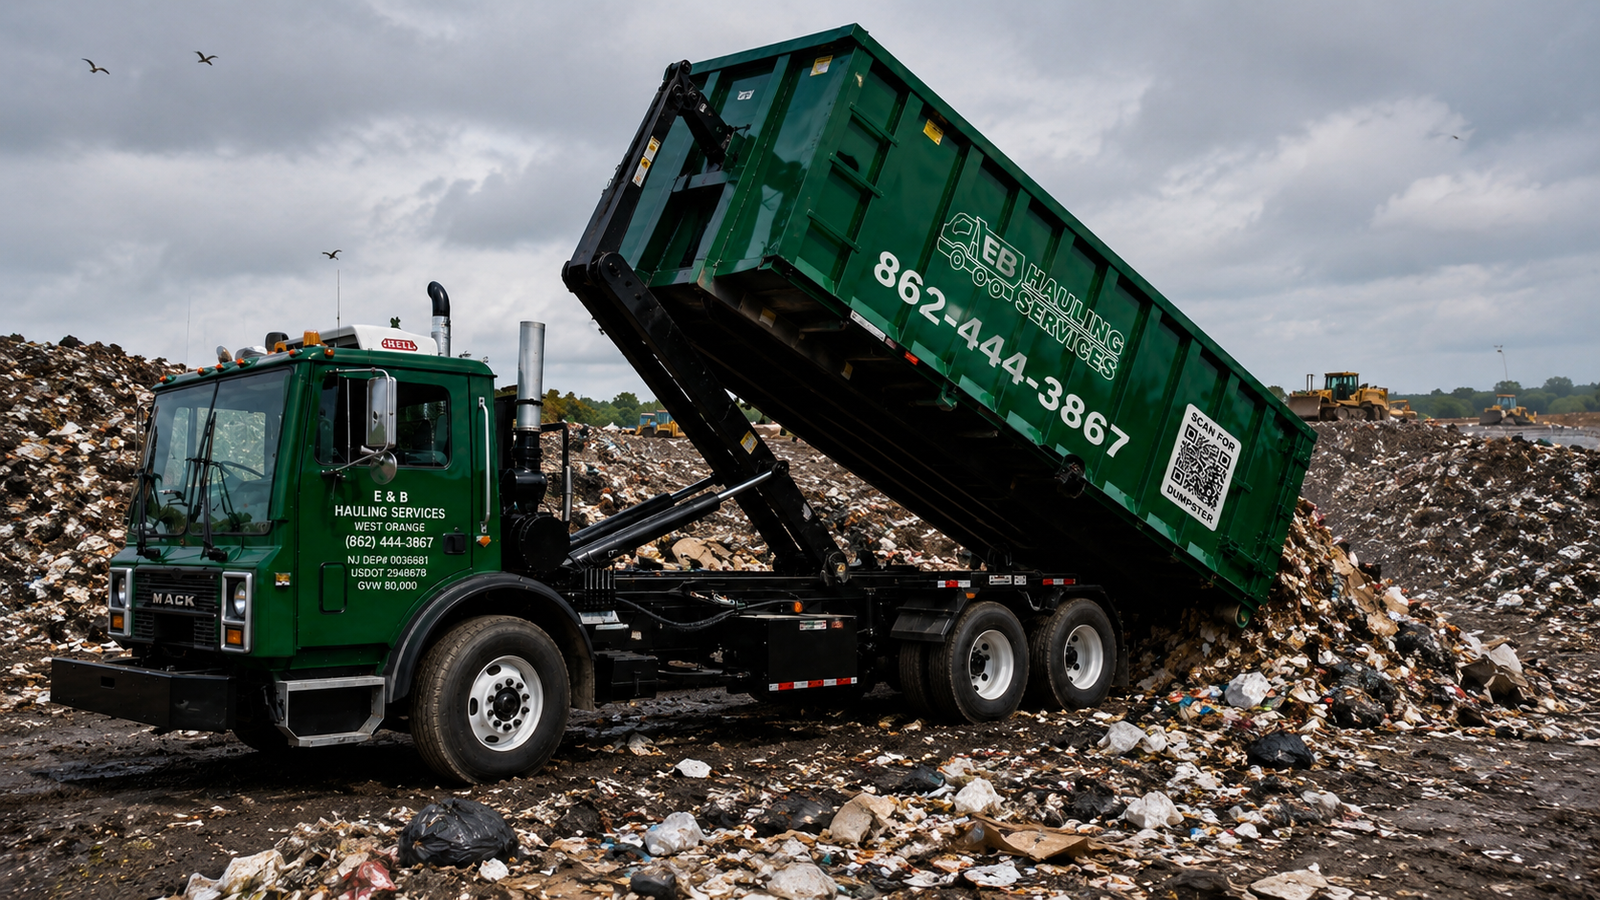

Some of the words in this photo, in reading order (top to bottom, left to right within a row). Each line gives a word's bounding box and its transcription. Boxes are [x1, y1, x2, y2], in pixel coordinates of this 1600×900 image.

[982, 234, 1017, 278] EB
[1024, 262, 1125, 356] HAULING
[1015, 289, 1117, 381] SERVICES
[873, 250, 1130, 458] 862-444-3867
[1190, 412, 1216, 437] SCAN
[1216, 432, 1236, 453] FOR
[374, 490, 382, 502] E
[386, 491, 396, 502] &
[400, 491, 408, 503] B
[1166, 484, 1214, 524] DUMPSTER
[334, 505, 388, 518] HAULING
[391, 506, 446, 519] SERVICES
[354, 521, 383, 531] WEST
[385, 522, 425, 532] ORANGE
[345, 535, 376, 549] (862)
[379, 536, 434, 548] 444-3867
[347, 555, 360, 565] NJ
[351, 568, 384, 578] USDOT
[357, 581, 382, 590] GVW
[384, 581, 417, 591] 80,000
[152, 592, 195, 607] MACK
